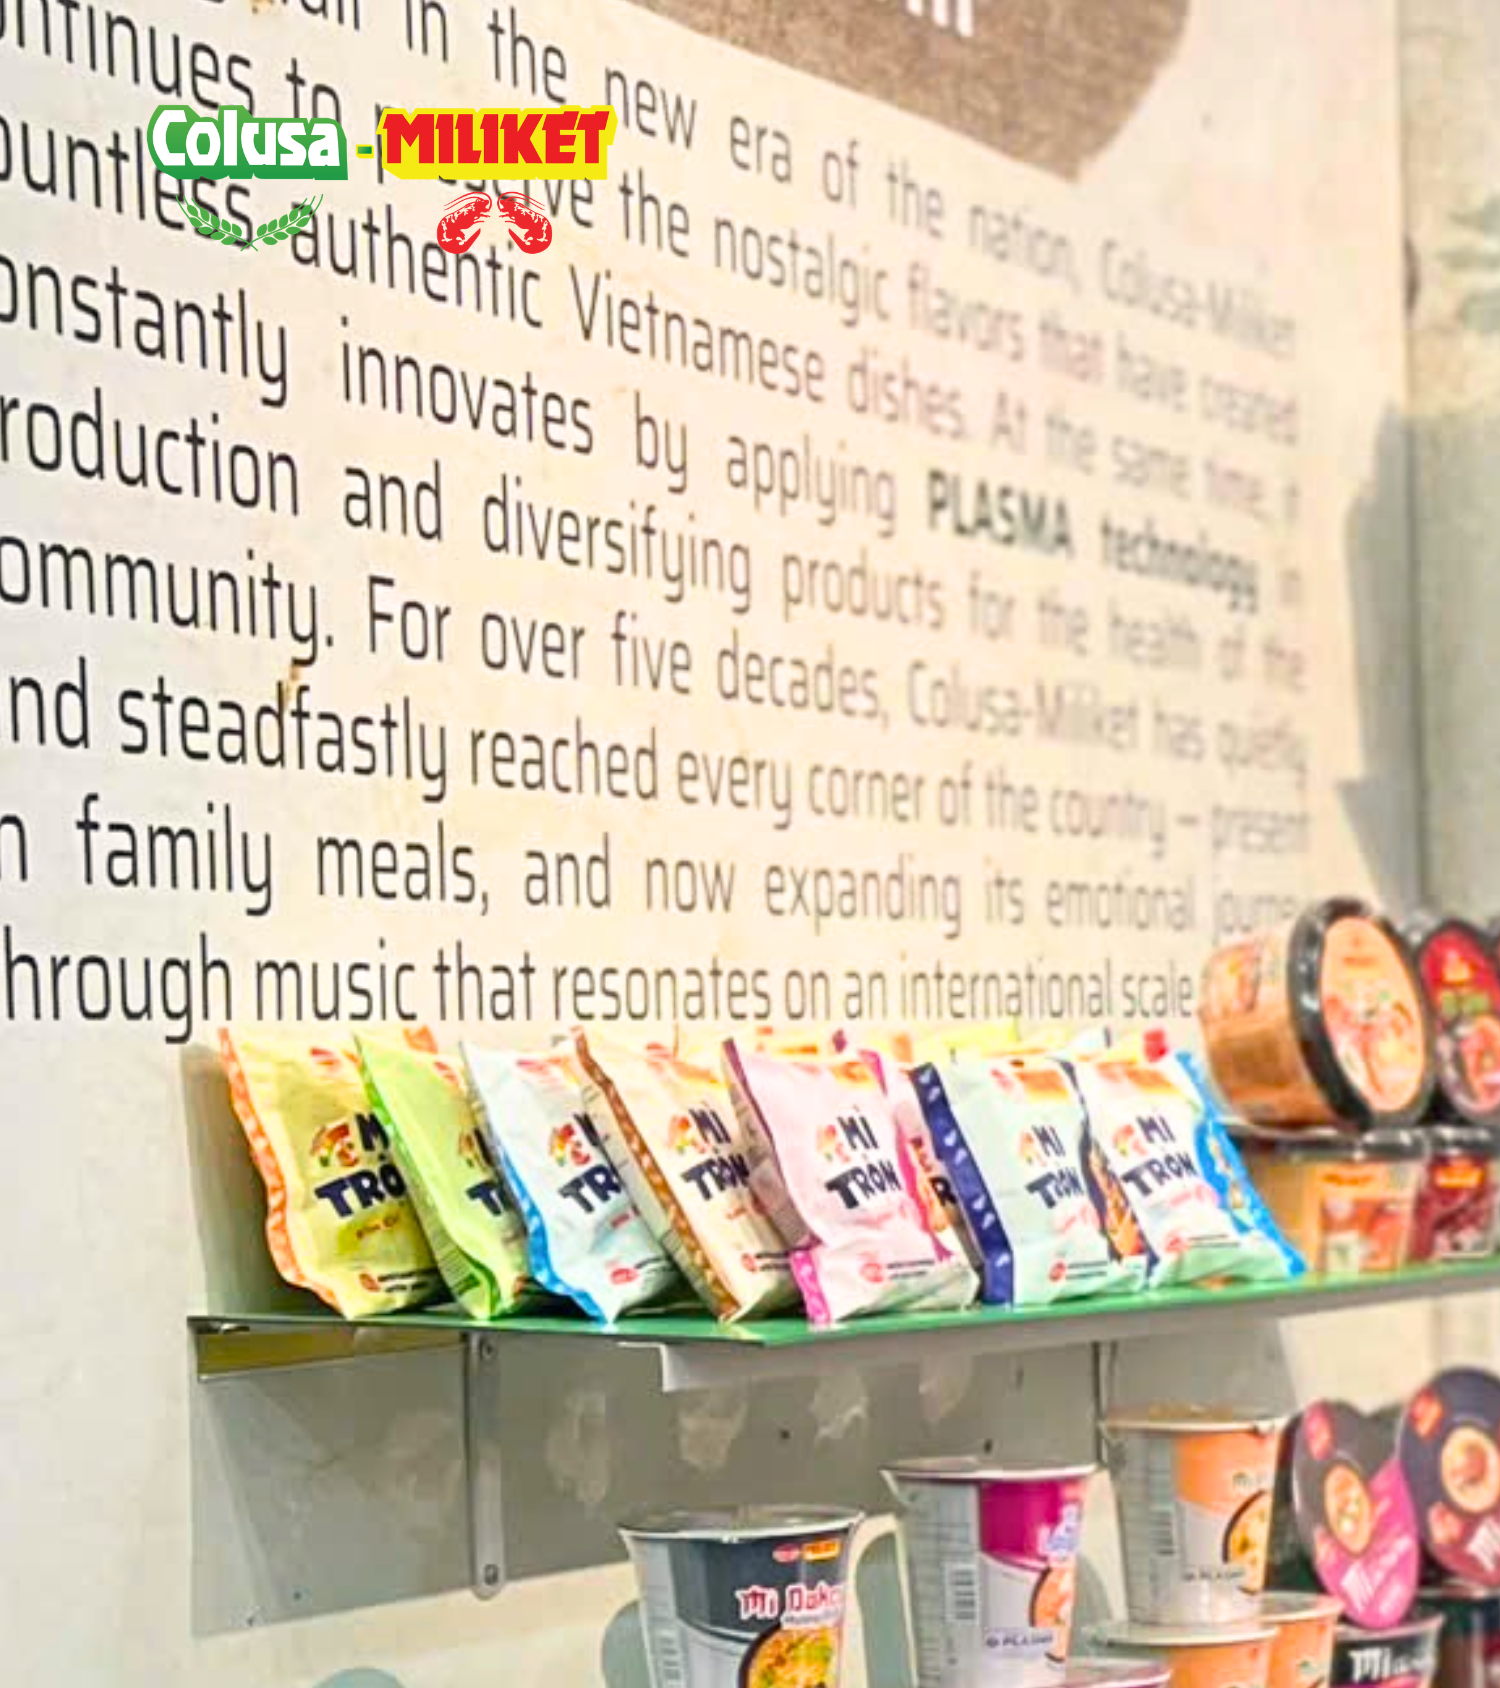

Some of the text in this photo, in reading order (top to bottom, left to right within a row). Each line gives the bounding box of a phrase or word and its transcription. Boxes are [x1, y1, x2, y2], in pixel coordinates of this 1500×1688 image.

[487, 7, 567, 104] the
[605, 66, 698, 150] new
[730, 114, 792, 183] era
[822, 140, 860, 207] of
[887, 160, 944, 239] the
[291, 201, 541, 328] authentic
[570, 263, 826, 404] Vietnamese
[618, 168, 690, 258] the
[715, 215, 888, 328] nostalgic
[340, 316, 594, 455] innovates
[633, 392, 689, 494] by
[727, 431, 897, 538] applying
[928, 468, 1076, 560] PLASMA
[345, 461, 443, 544] and
[483, 475, 751, 615] diversifying
[782, 545, 944, 632] products
[366, 575, 451, 662] For
[480, 611, 586, 681] over
[610, 611, 693, 695] five
[717, 629, 890, 728] decades,
[118, 674, 449, 804] steadfastly
[470, 715, 659, 801] reached
[677, 748, 794, 831] every
[808, 766, 925, 824] corner
[938, 759, 973, 827] of
[985, 763, 1039, 834] the
[76, 793, 273, 916] family
[317, 819, 491, 916] meals,
[524, 832, 611, 911] and
[646, 856, 735, 914] now
[764, 855, 962, 940] expanding
[984, 856, 1026, 927] its
[256, 938, 417, 1022] music
[434, 940, 537, 1022] that
[553, 955, 770, 1022] resonates
[784, 969, 834, 1022] on
[844, 969, 888, 1022] an
[900, 951, 1112, 1022] international
